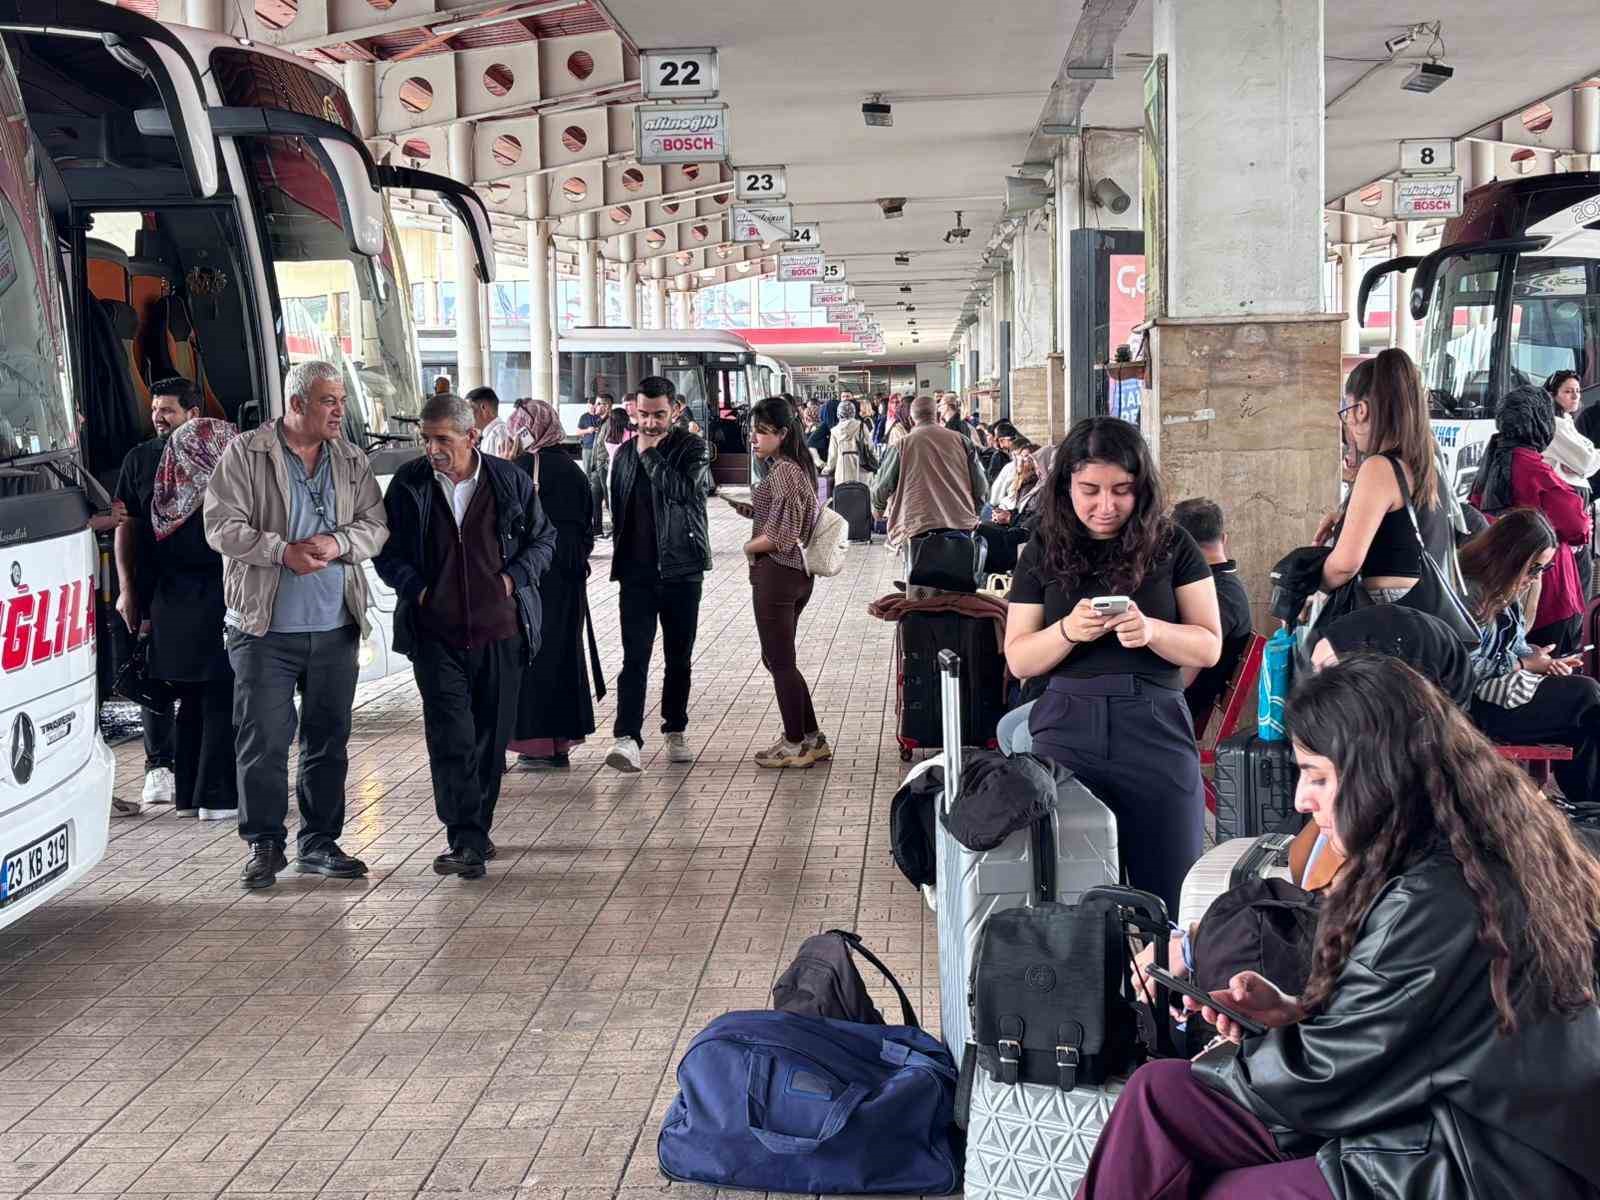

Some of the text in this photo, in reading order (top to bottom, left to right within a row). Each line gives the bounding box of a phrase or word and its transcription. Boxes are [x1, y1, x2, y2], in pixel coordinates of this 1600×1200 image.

[660, 61, 701, 86] 22
[663, 138, 714, 151] BOSCH
[1421, 147, 1434, 164] 8
[746, 174, 774, 191] 23
[1414, 201, 1451, 210] BOSCH
[793, 229, 811, 242] 24
[791, 268, 817, 277] BOSCH
[8, 857, 23, 891] 23
[29, 846, 43, 881] KB
[47, 833, 65, 868] 319
